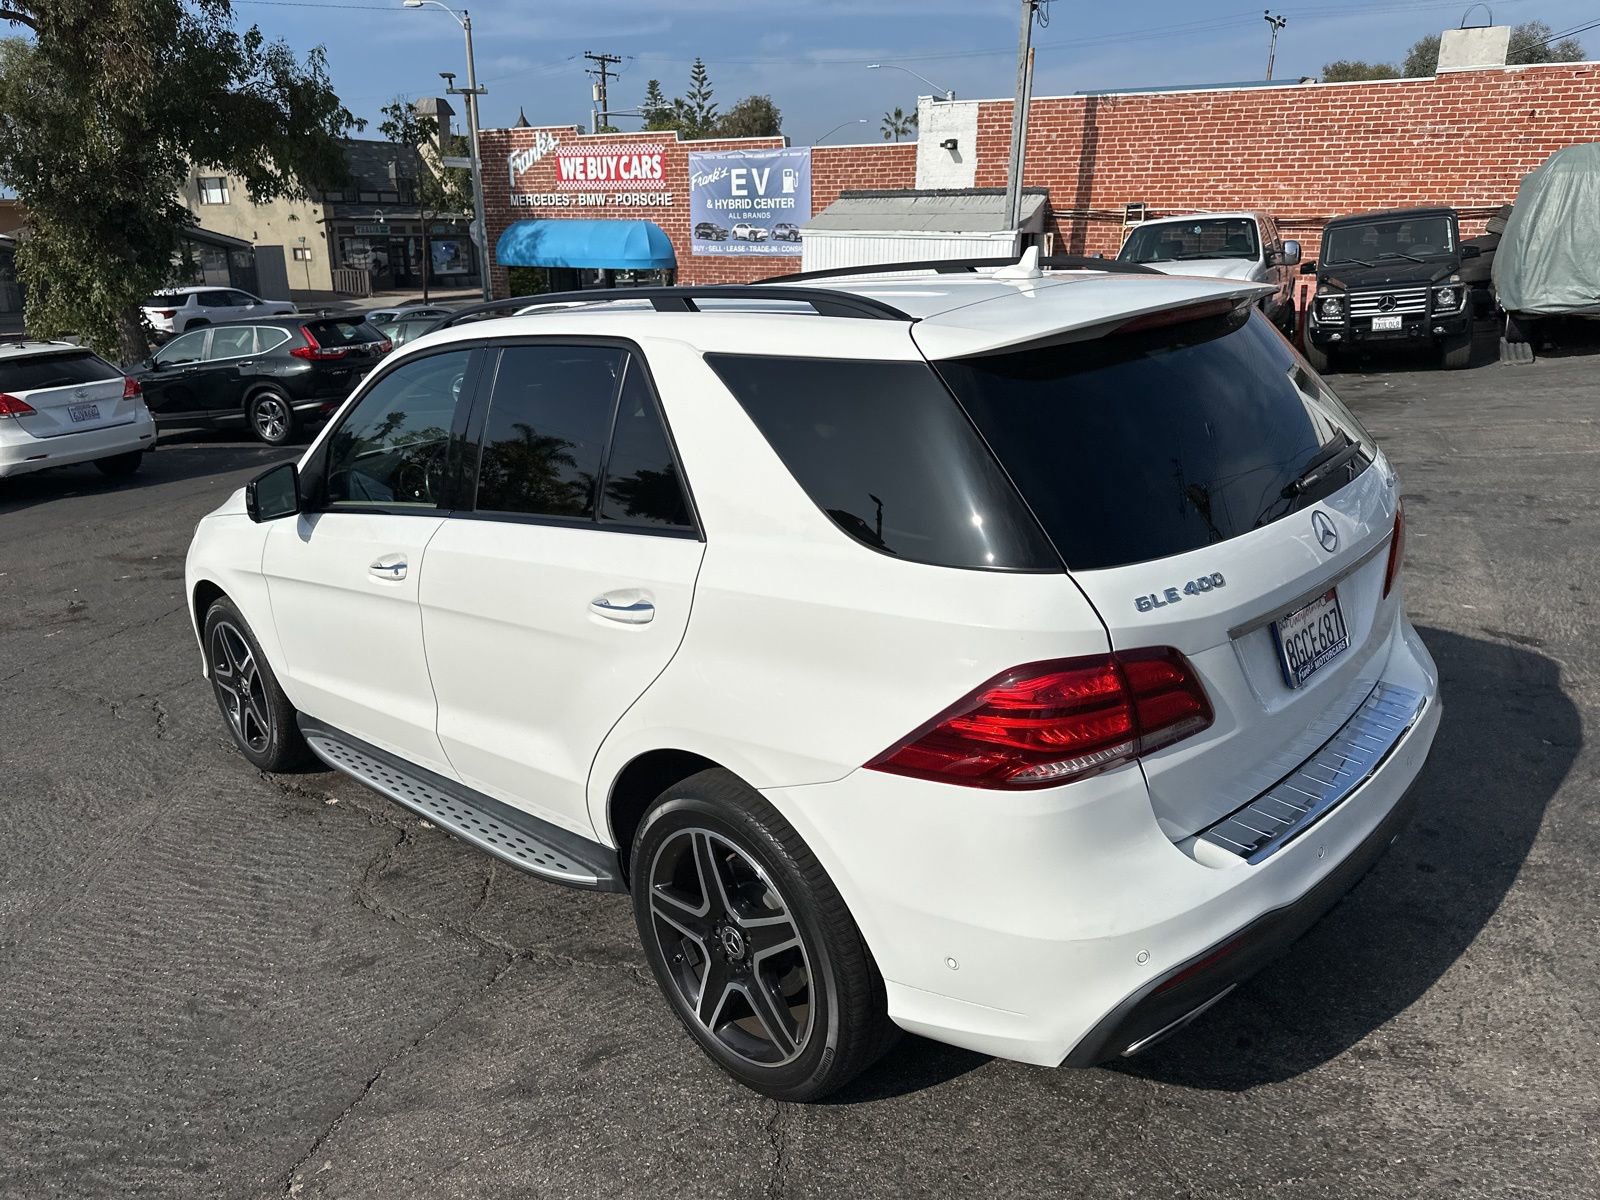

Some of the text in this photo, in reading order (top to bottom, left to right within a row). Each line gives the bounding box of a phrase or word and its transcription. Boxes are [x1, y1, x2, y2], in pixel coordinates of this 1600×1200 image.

[508, 131, 559, 188] Frank's
[559, 155, 662, 180] WE BUY CARS
[691, 167, 729, 191] Frank's
[731, 168, 771, 196] EV
[510, 193, 673, 206] MERCEDES BMW PORSCHE
[706, 198, 795, 209] & HYBRID CENTER
[1134, 572, 1227, 612] GLE 400
[1285, 608, 1341, 672] 8GCE687
[1314, 640, 1346, 670] MOTORCARS
